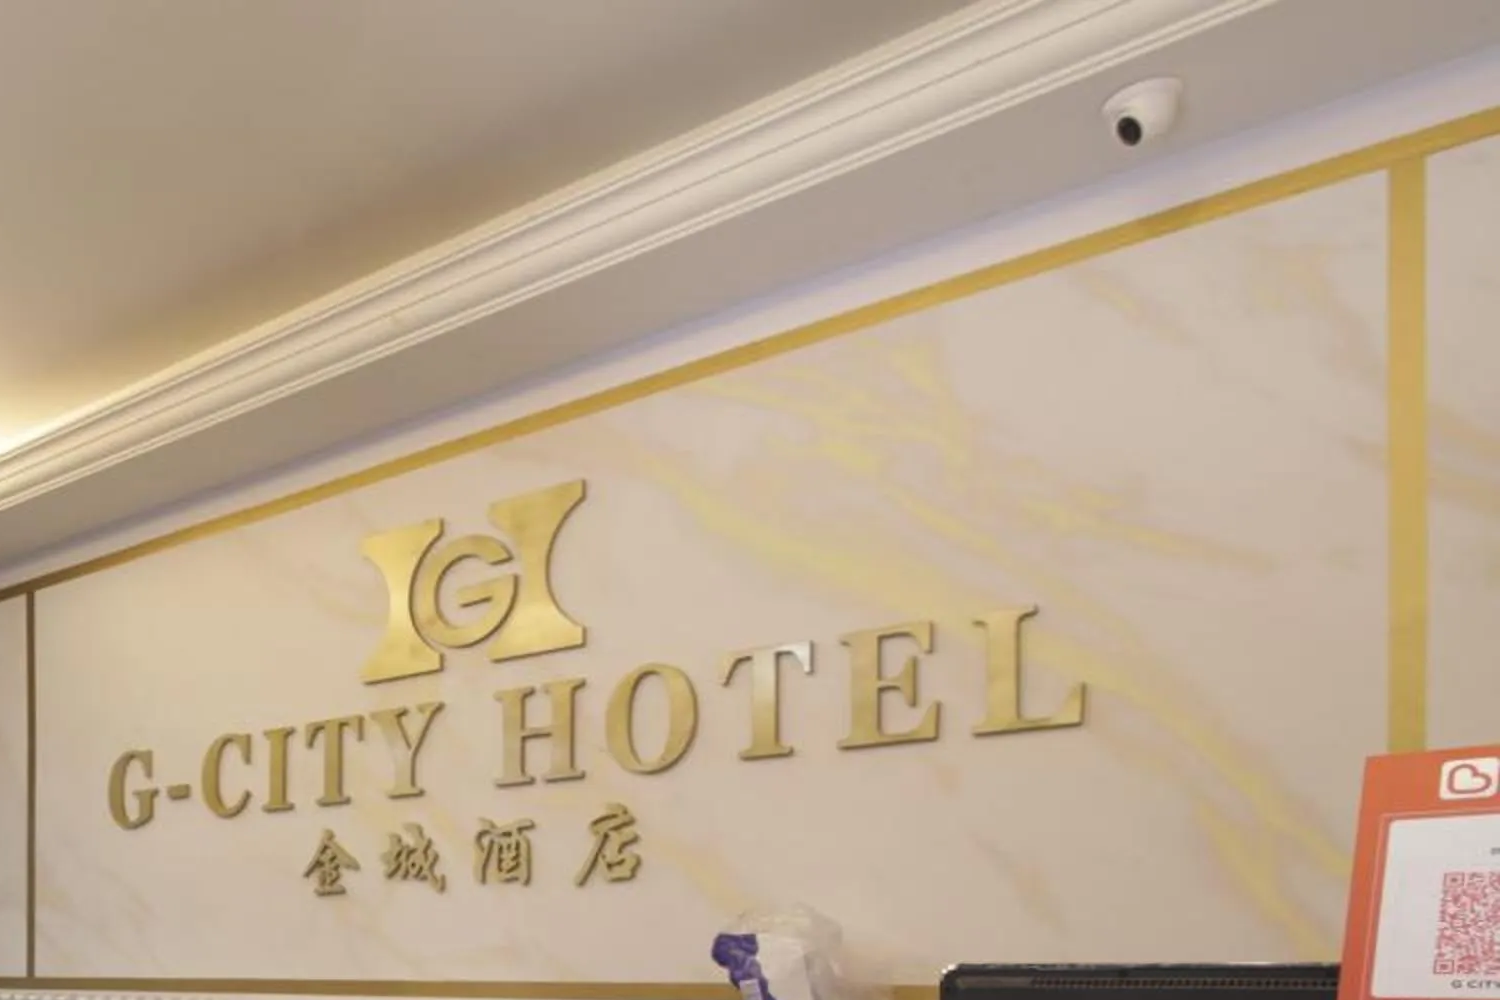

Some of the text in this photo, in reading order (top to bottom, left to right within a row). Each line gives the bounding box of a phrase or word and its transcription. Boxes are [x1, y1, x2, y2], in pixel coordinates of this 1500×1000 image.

[108, 604, 1088, 830] G-CITY HOTEL
[304, 802, 642, 897] 金城酒店
